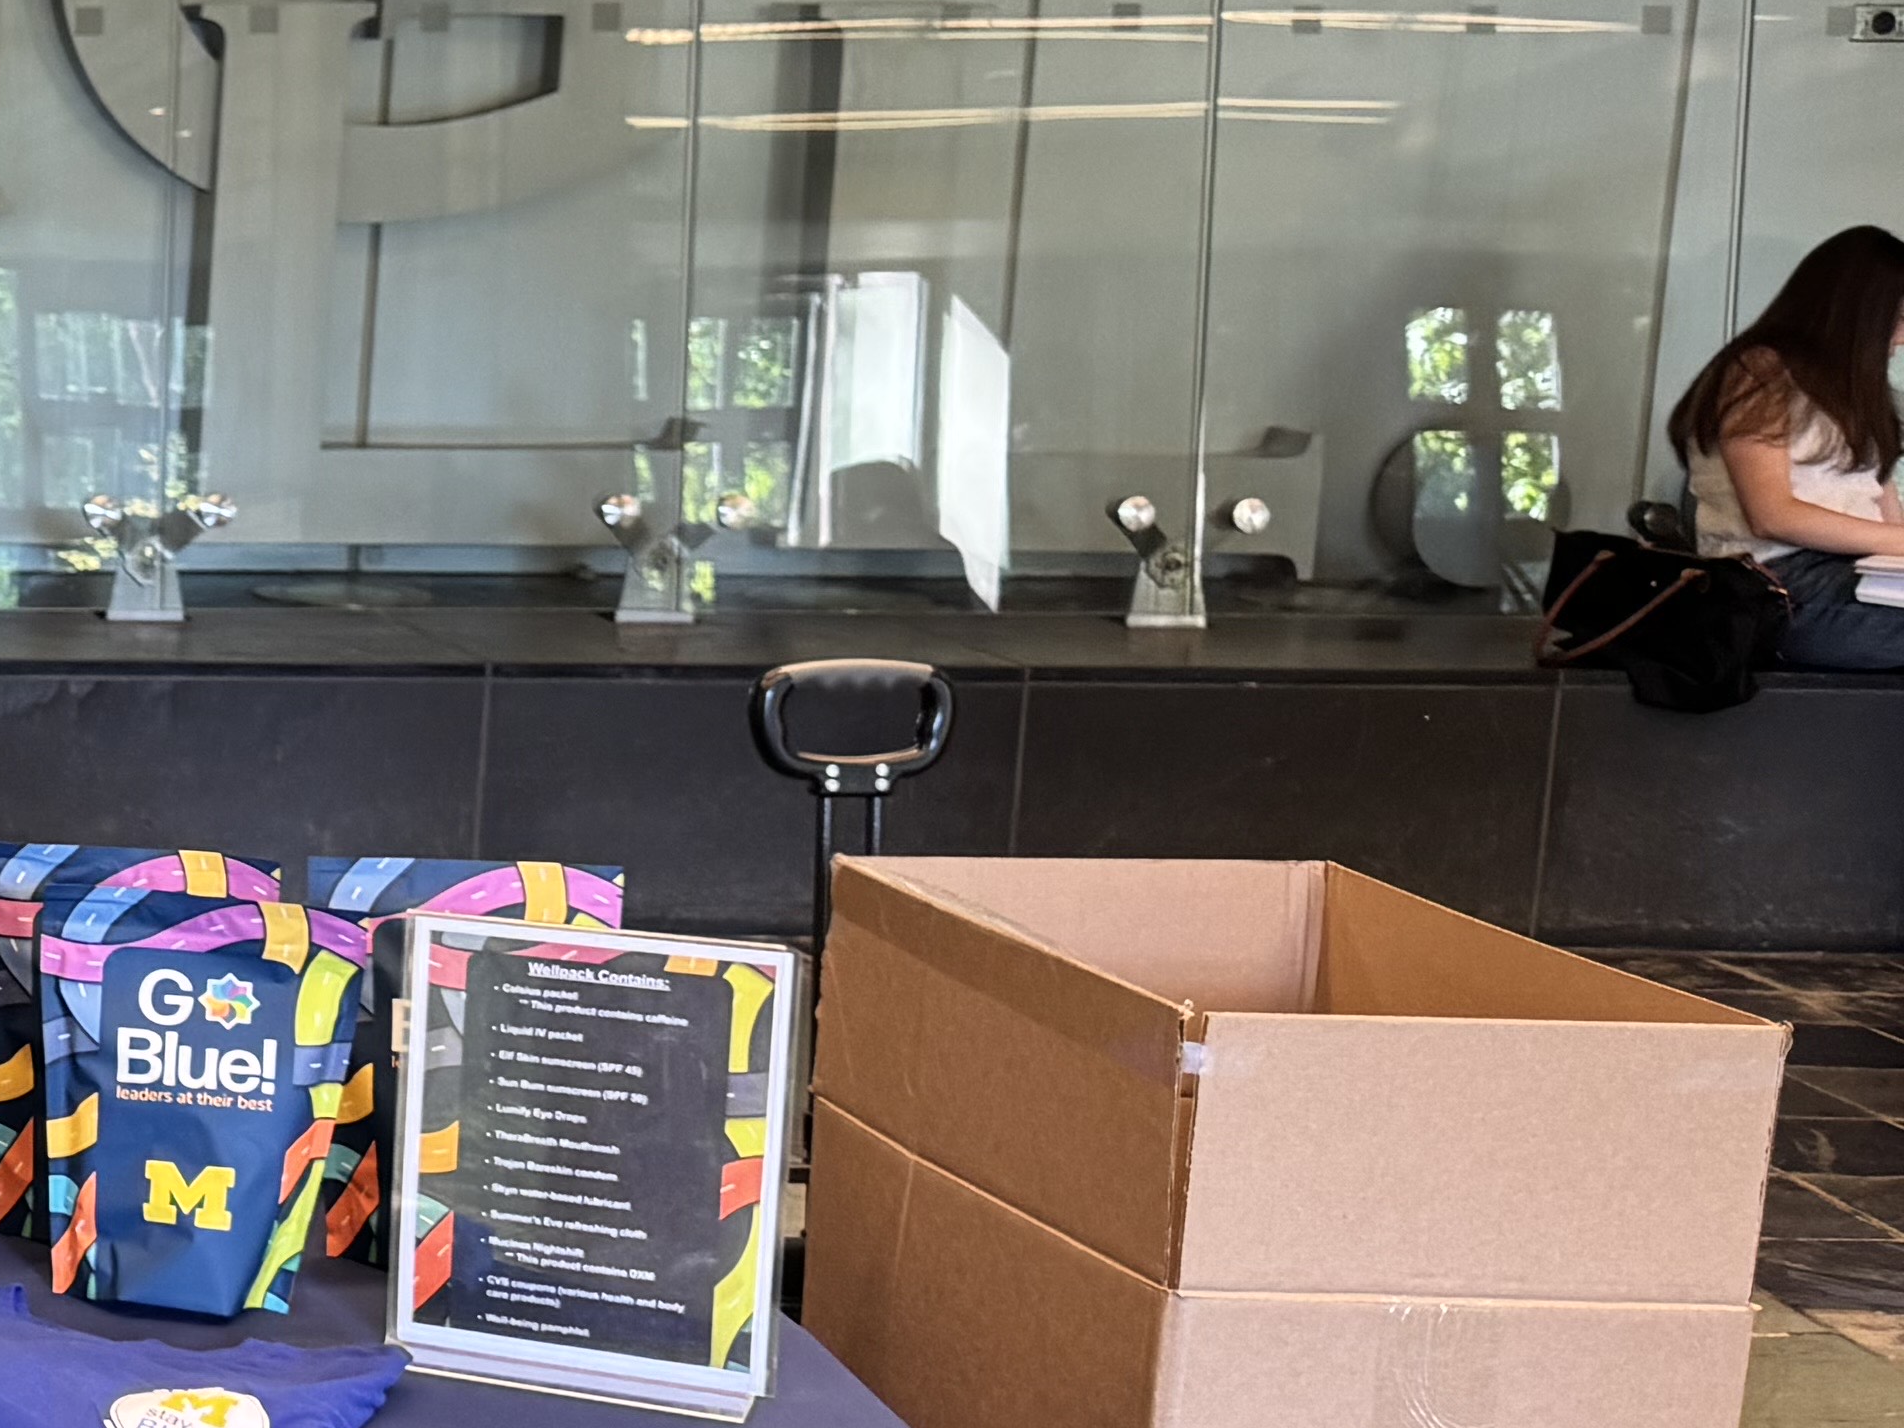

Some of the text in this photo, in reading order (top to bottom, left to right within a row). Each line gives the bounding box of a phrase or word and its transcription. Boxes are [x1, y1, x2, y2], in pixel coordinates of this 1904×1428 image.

[528, 962, 671, 989] Wellpack Contains:
[116, 1027, 279, 1093] Blue!
[116, 1086, 274, 1113] leaders at their best
[143, 1159, 236, 1232] M
[160, 1392, 239, 1428] M
